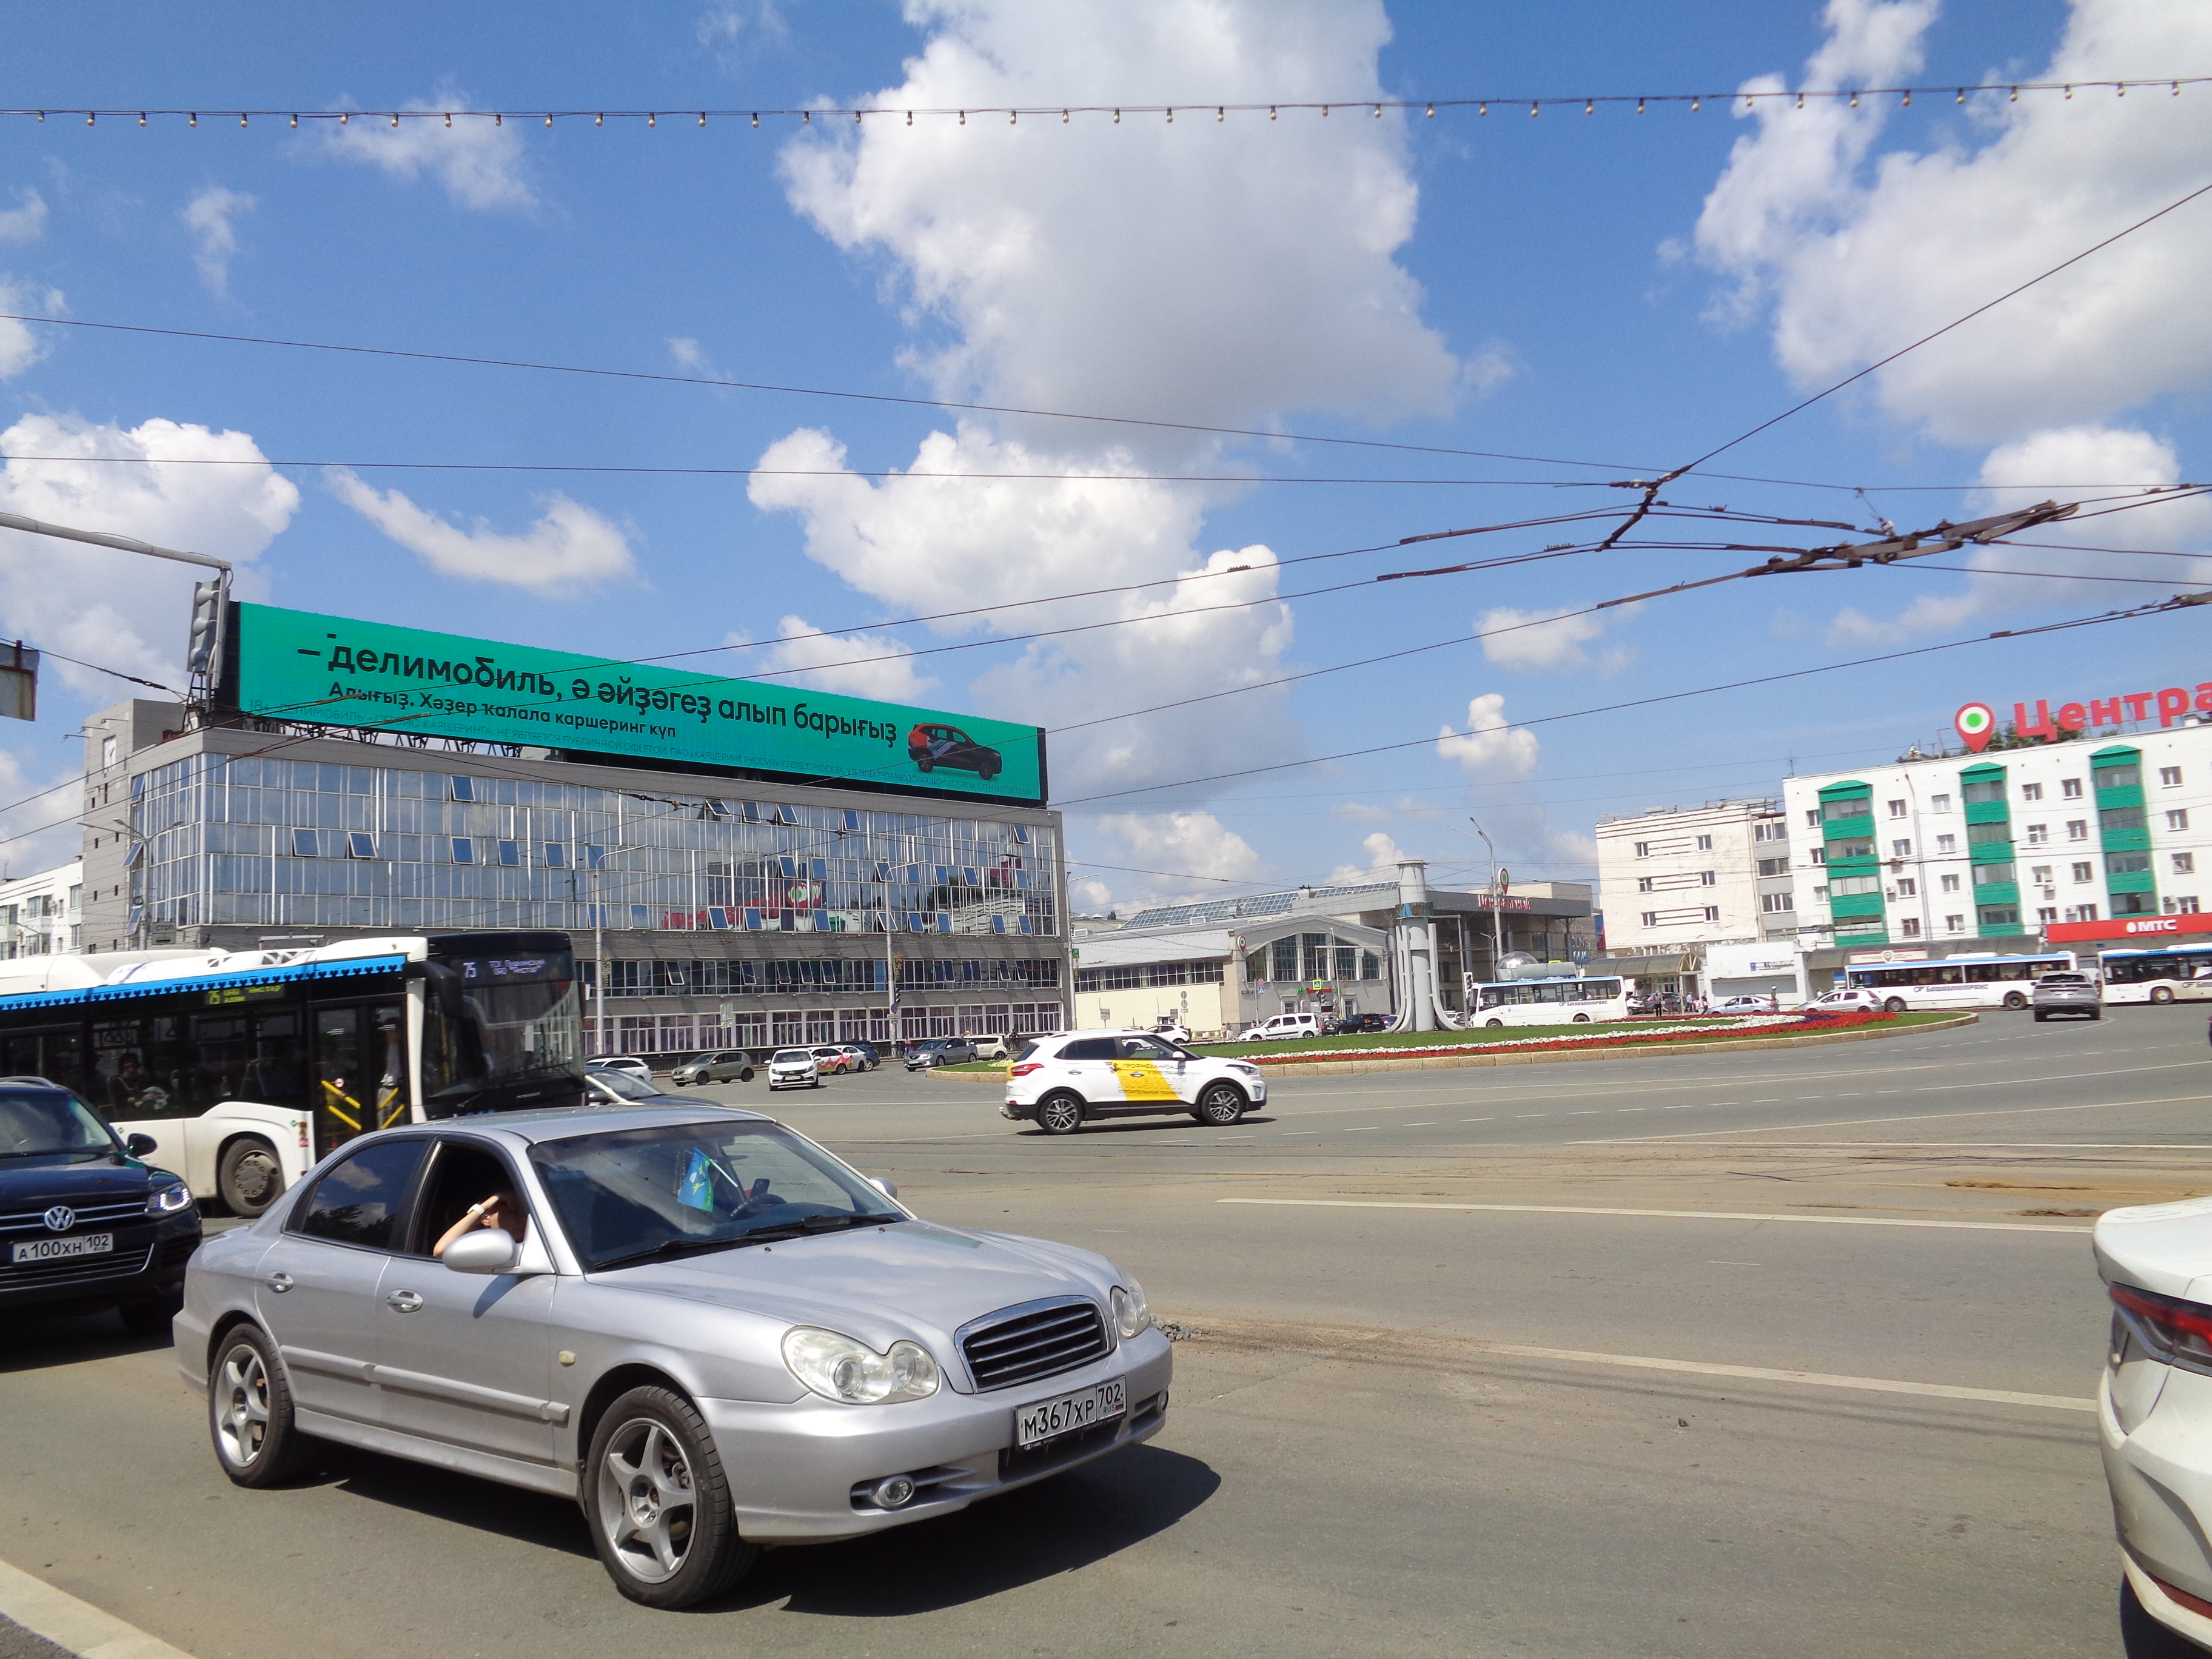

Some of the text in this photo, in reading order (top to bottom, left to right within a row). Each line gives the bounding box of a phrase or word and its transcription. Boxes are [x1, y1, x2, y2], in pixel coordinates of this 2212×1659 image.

[328, 645, 562, 701] делимобиль,
[572, 679, 590, 699] ә
[718, 699, 786, 726] алып
[793, 703, 897, 748] барығыҙ
[555, 711, 646, 734] каршеринг
[649, 723, 676, 740] күп
[497, 728, 512, 739] НЕ
[512, 729, 560, 743] ЯВЛЯЕТСЯ
[563, 735, 622, 749] ПУБЛИЧНОЙ
[670, 747, 689, 758] ПАО
[931, 777, 947, 787] ДОМ
[1478, 894, 1531, 912] Ценральный
[463, 962, 477, 978] 75
[208, 990, 220, 1005] 75
[86, 1235, 109, 1247] 102
[1098, 1382, 1121, 1408] 702
[1103, 1404, 1115, 1414] RUS
